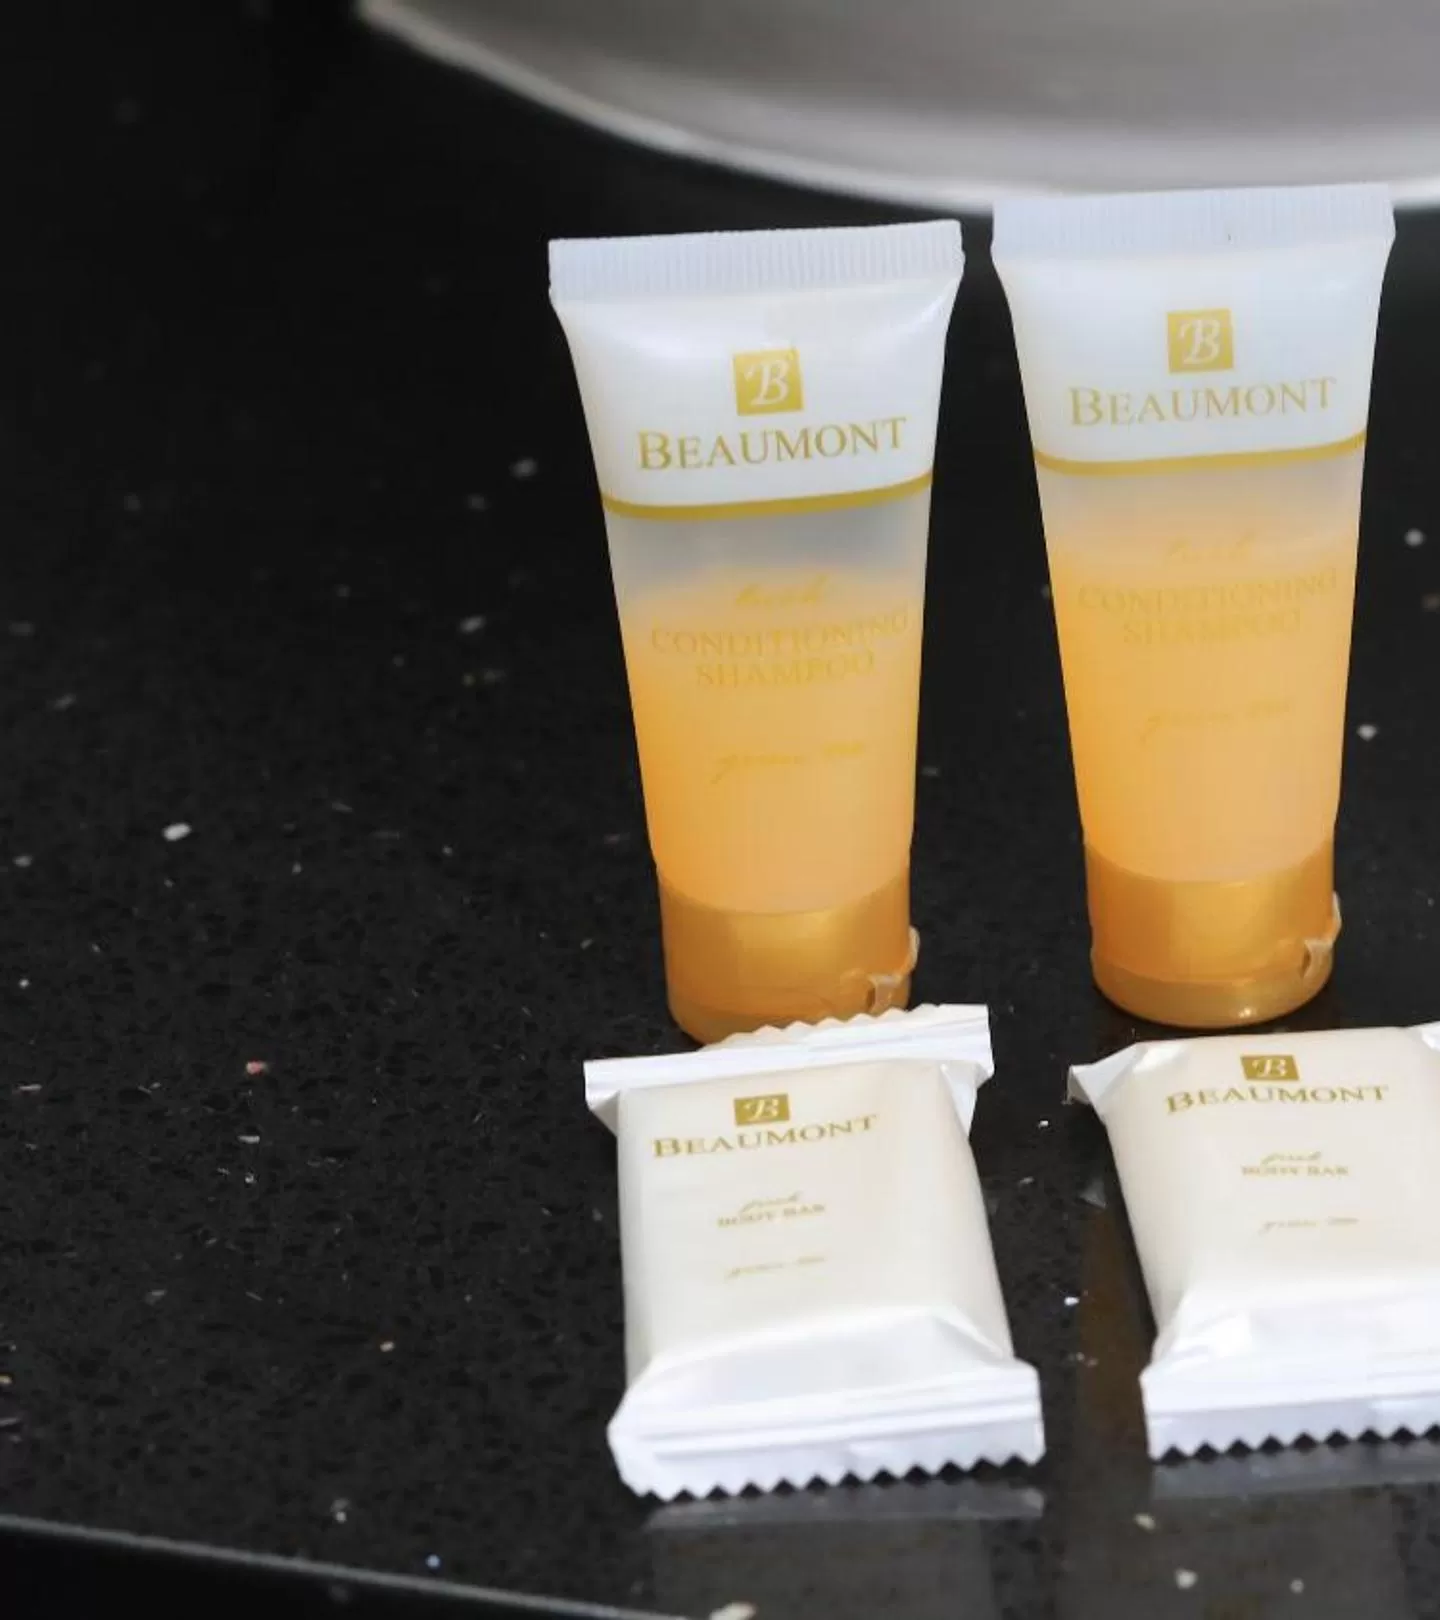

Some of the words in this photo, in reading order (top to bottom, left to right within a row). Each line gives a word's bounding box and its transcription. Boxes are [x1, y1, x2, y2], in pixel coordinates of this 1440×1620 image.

[1068, 376, 1337, 427] BEAUMONT
[638, 416, 907, 470] BEAUMONT
[1166, 1085, 1388, 1115] BEAUMONT
[653, 1114, 878, 1158] BEAUMONT
